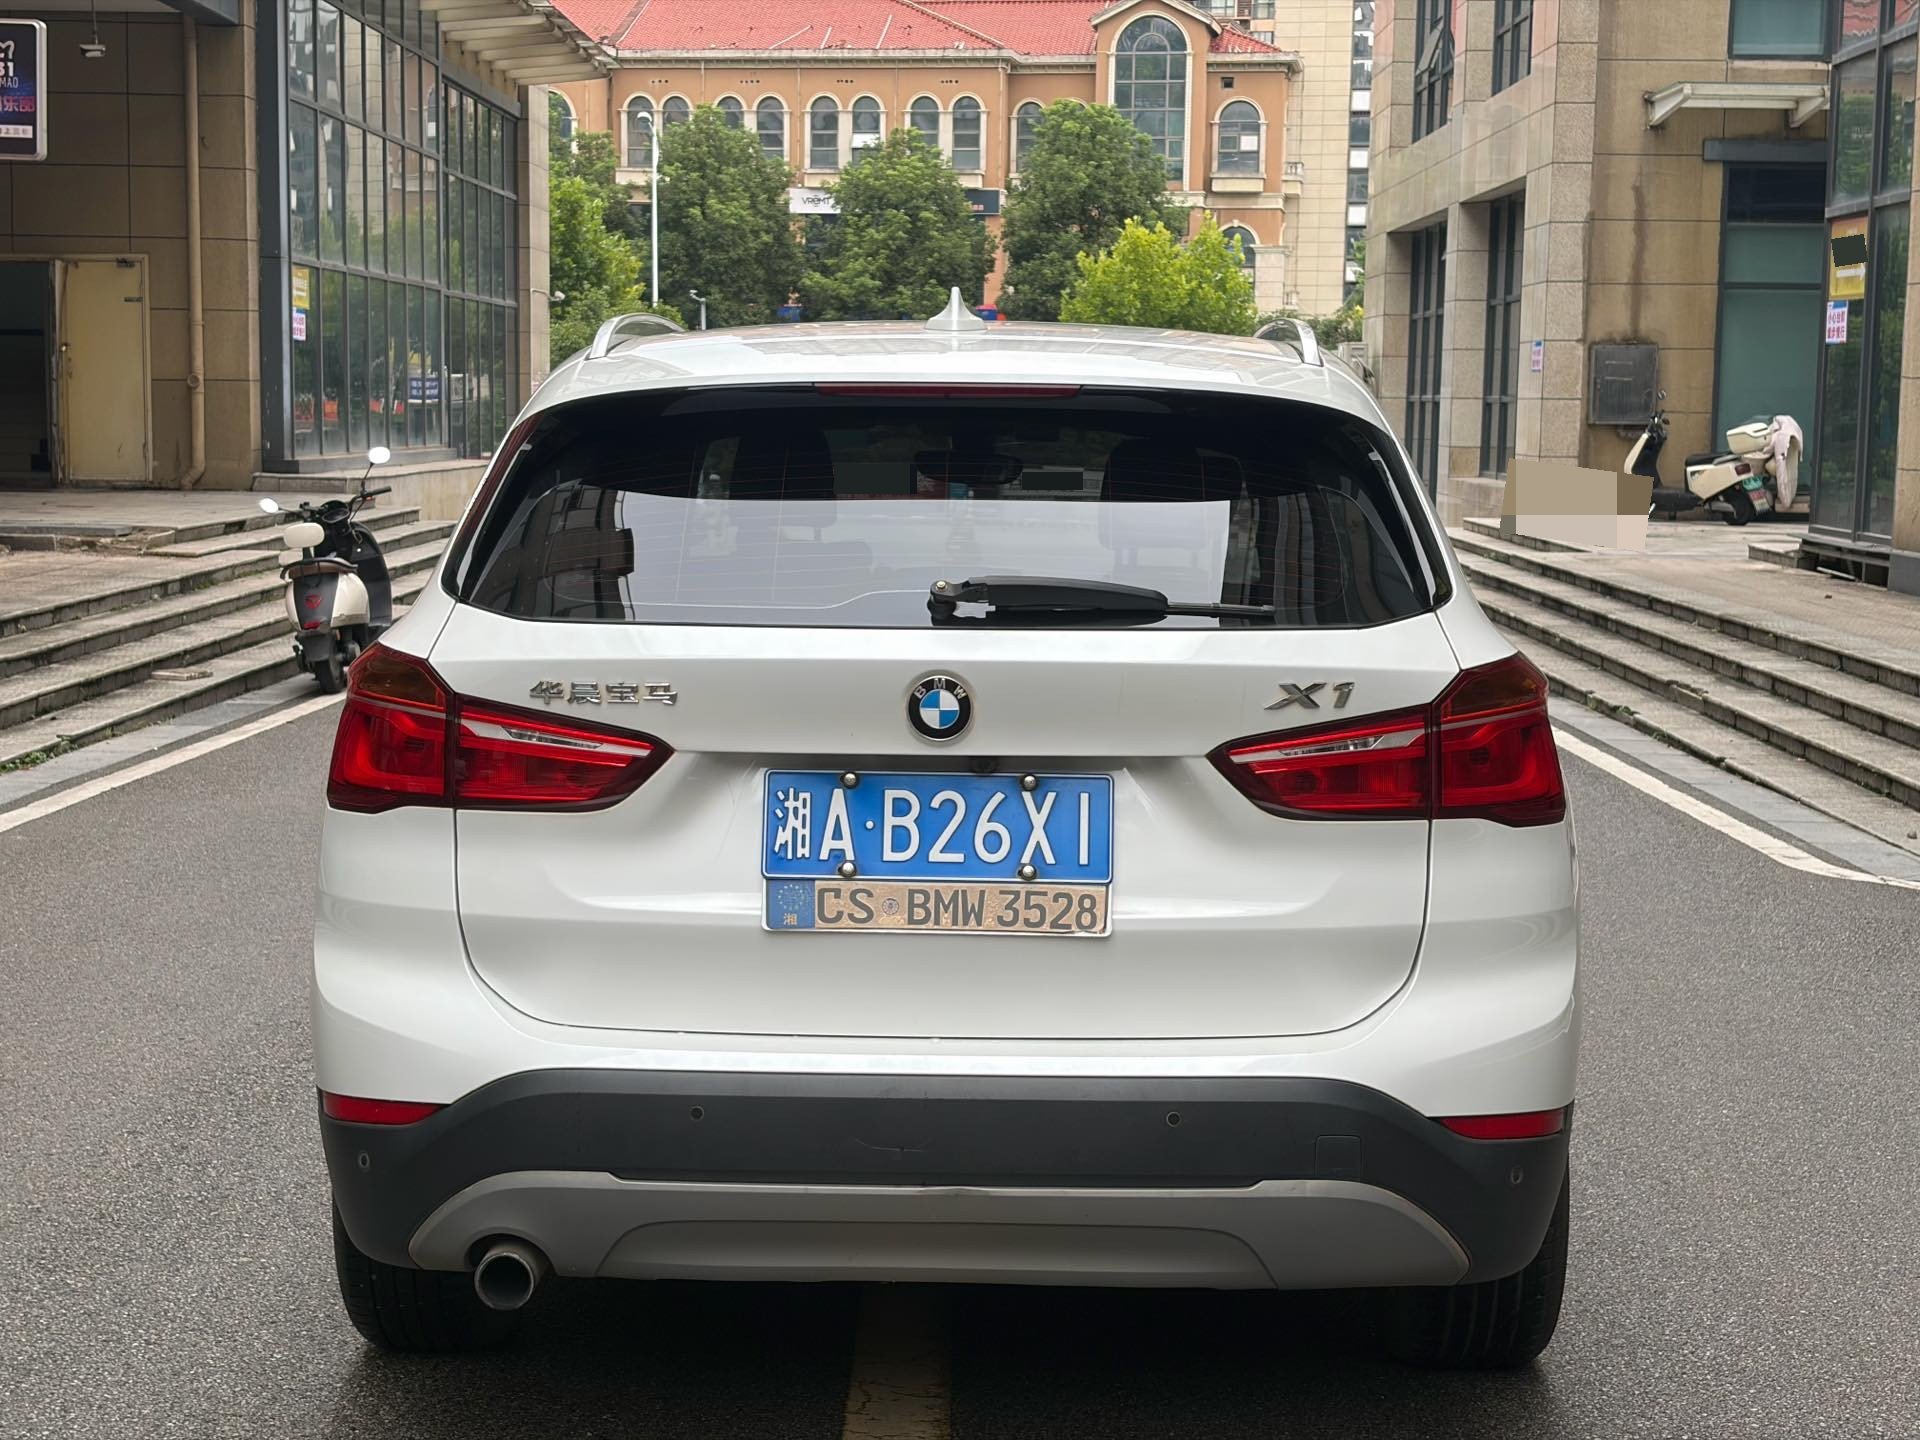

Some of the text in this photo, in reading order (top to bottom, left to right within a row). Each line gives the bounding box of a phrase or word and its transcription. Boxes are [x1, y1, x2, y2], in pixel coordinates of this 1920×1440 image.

[530, 680, 678, 705] 华晨宝马
[913, 678, 967, 699] BMW
[1263, 682, 1355, 710] X1
[817, 887, 1098, 931] CS BMW 3528
